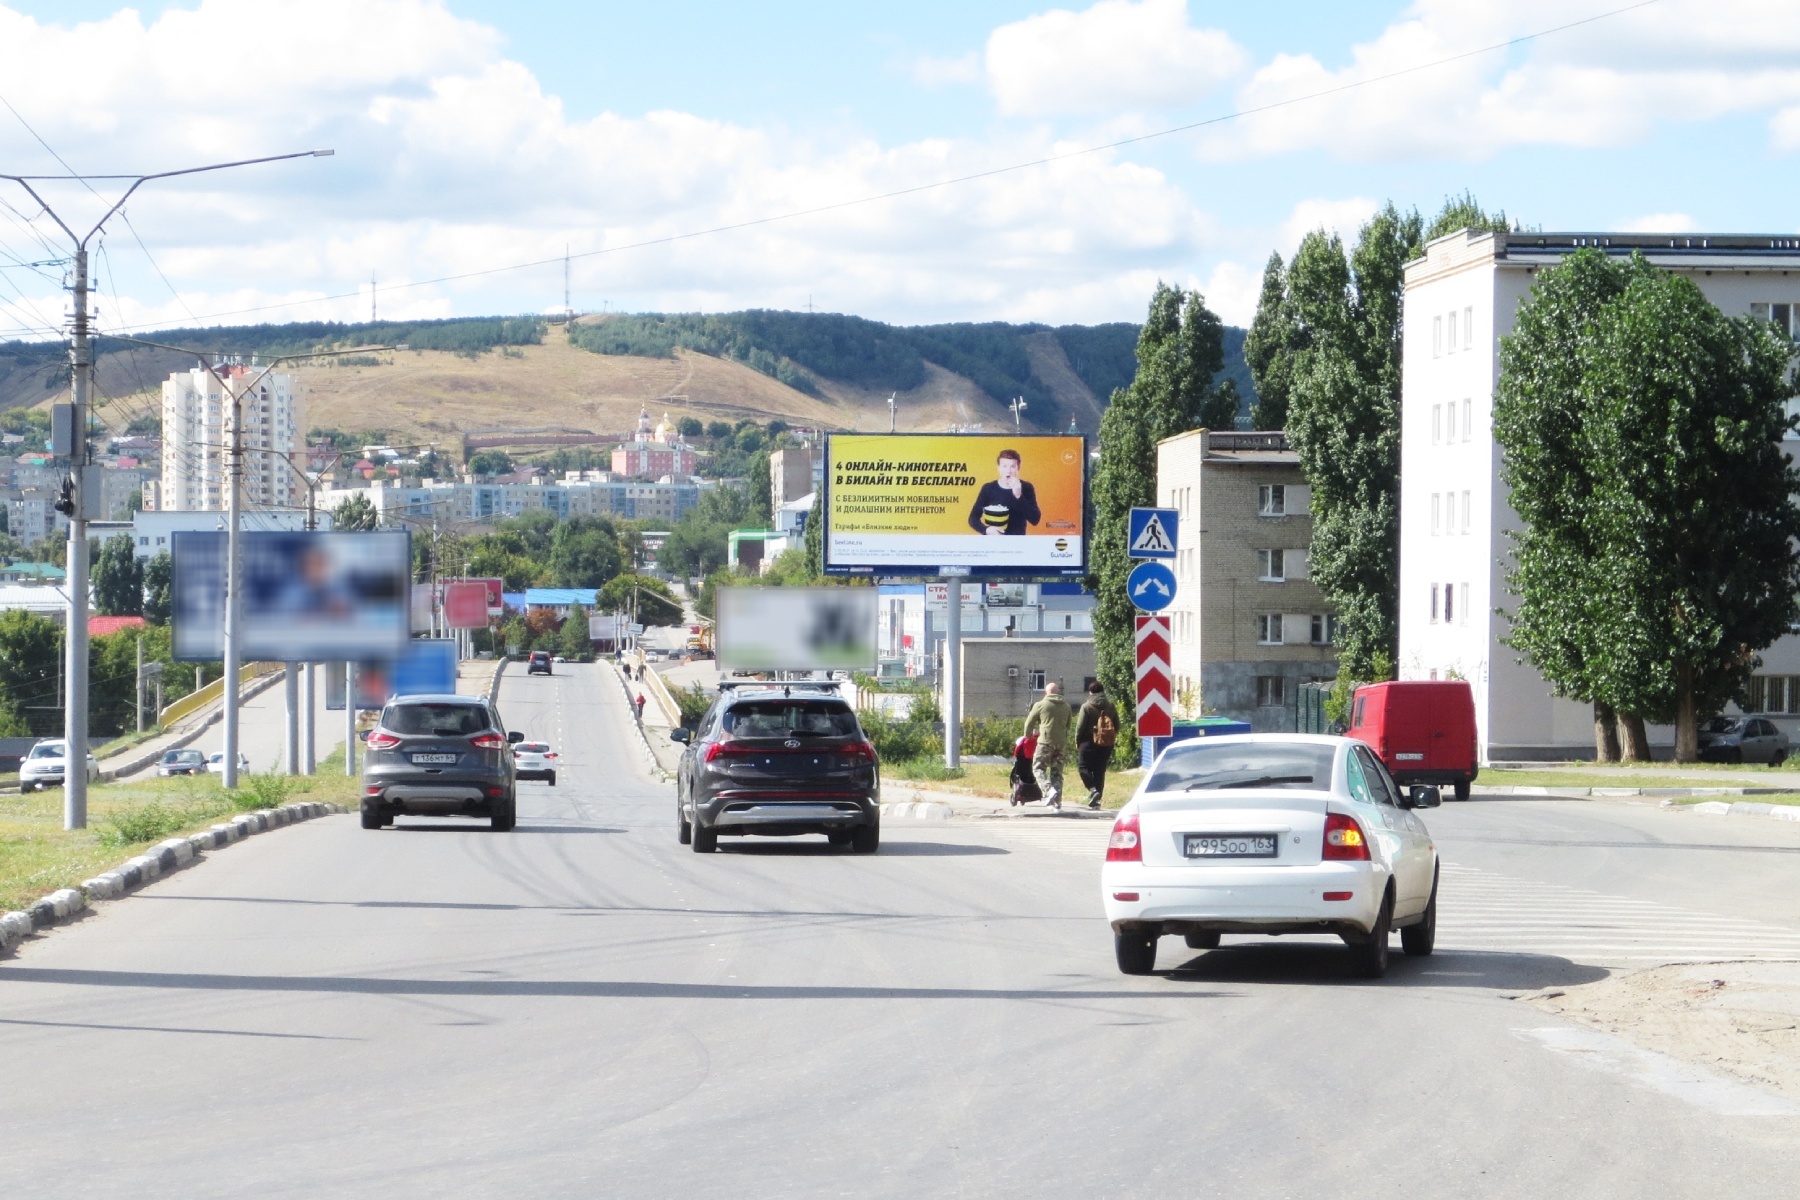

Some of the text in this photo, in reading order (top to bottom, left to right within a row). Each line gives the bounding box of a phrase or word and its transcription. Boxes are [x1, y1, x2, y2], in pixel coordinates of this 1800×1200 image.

[836, 459, 968, 472] 4 ОНЛАЙН-КИНОТЕАТРА
[836, 473, 976, 486] В БИЛАЙН ТВ БЕСПЛАТНО
[835, 494, 960, 504] С БЕЗЛИМИТНЫМ МОБИЛЬНЫМ
[835, 505, 946, 514] И ДОМАШНИМ ИНТЕРНЕТОМ
[835, 523, 861, 531] Тарифы
